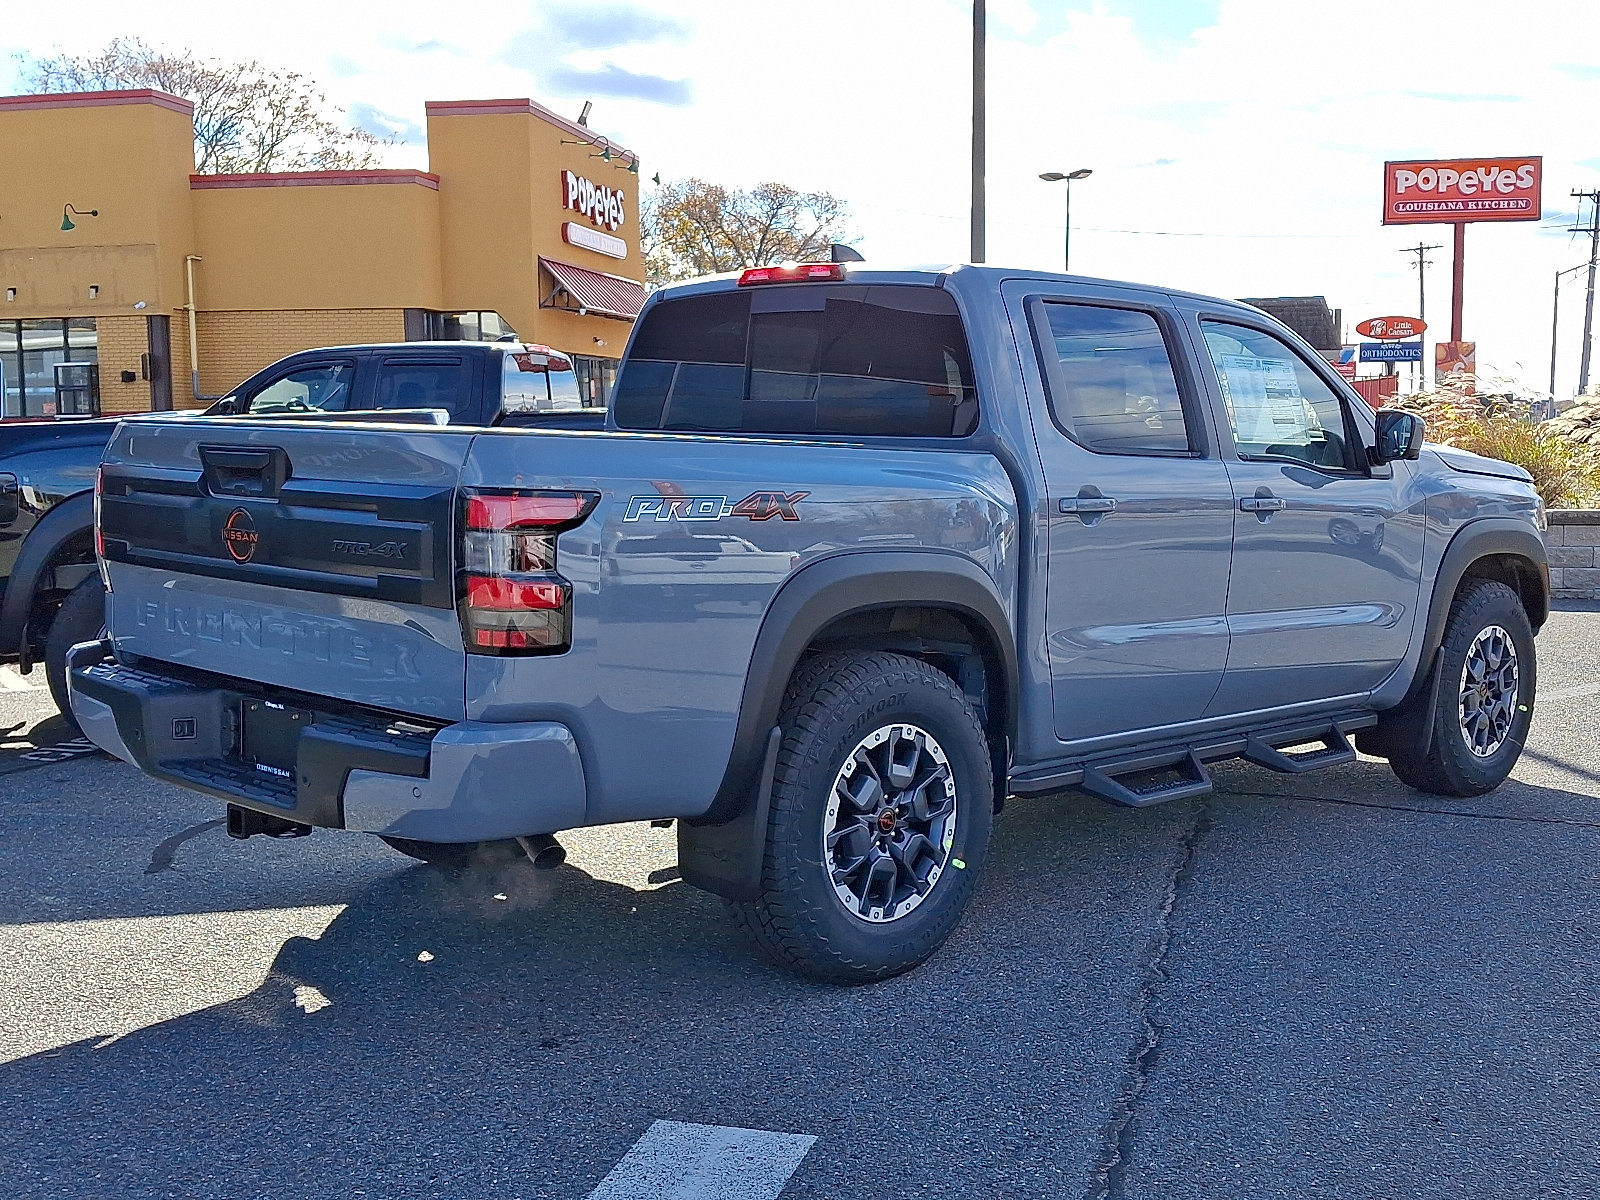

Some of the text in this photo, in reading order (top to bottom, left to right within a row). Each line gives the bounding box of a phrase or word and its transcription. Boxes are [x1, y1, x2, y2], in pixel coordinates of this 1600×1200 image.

[1399, 199, 1528, 212] LOUISIANA KITCHEN
[1388, 328, 1414, 336] Caesars
[1393, 321, 1412, 329] Little
[1361, 349, 1422, 358] ORTHODONTICS
[622, 490, 812, 523] PRO-4X
[223, 528, 259, 544] NISSAN
[331, 538, 409, 560] PRO-4X
[135, 597, 423, 682] FRONTIER
